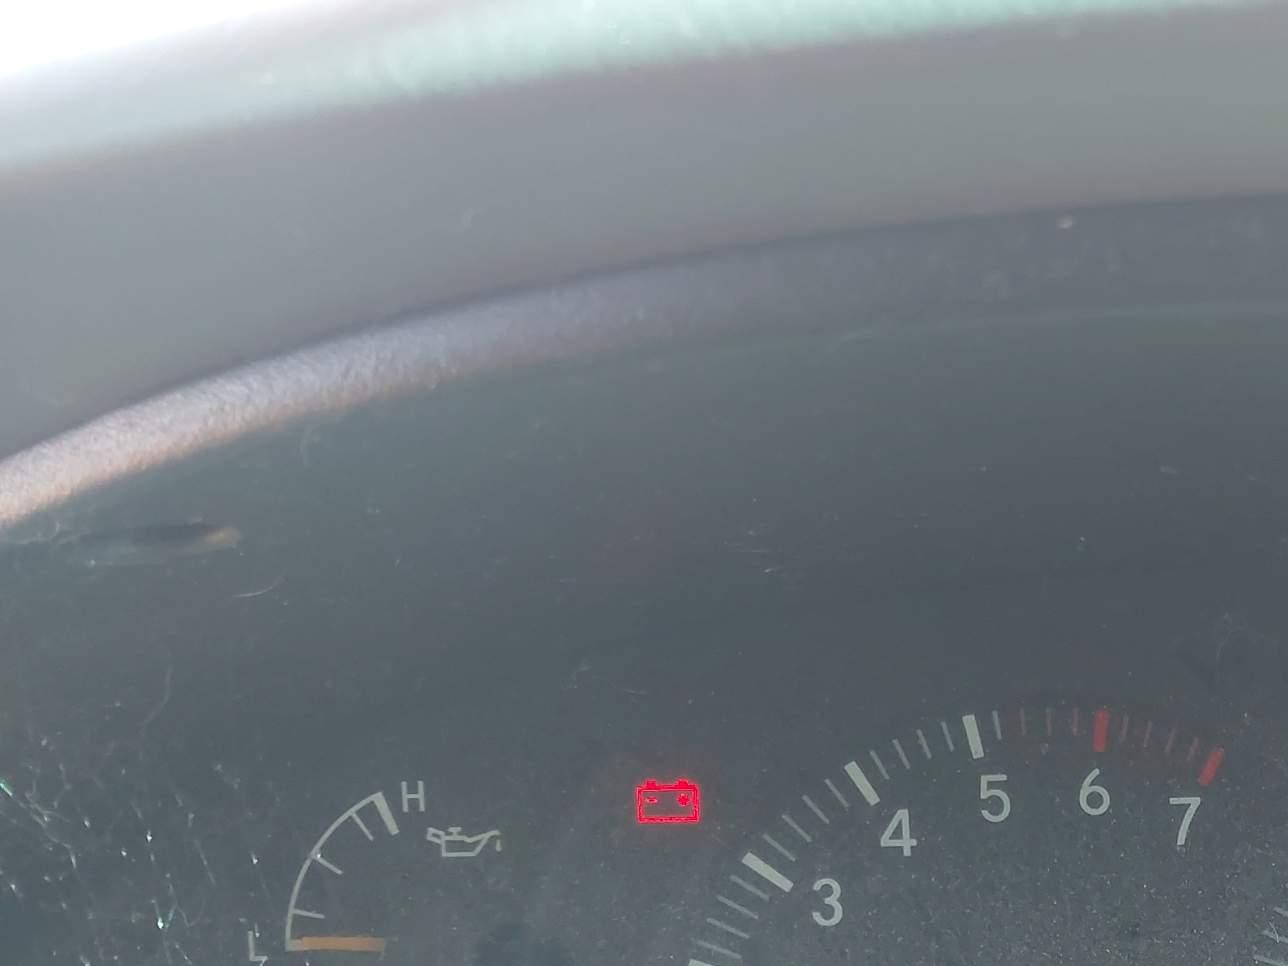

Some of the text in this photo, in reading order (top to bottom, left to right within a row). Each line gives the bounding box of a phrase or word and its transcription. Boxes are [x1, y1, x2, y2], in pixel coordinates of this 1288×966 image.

[401, 780, 425, 812] H
[978, 773, 1012, 823] 5
[1078, 768, 1111, 816] 6
[879, 808, 918, 857] 4
[1168, 796, 1202, 845] 7
[811, 878, 844, 926] 3
